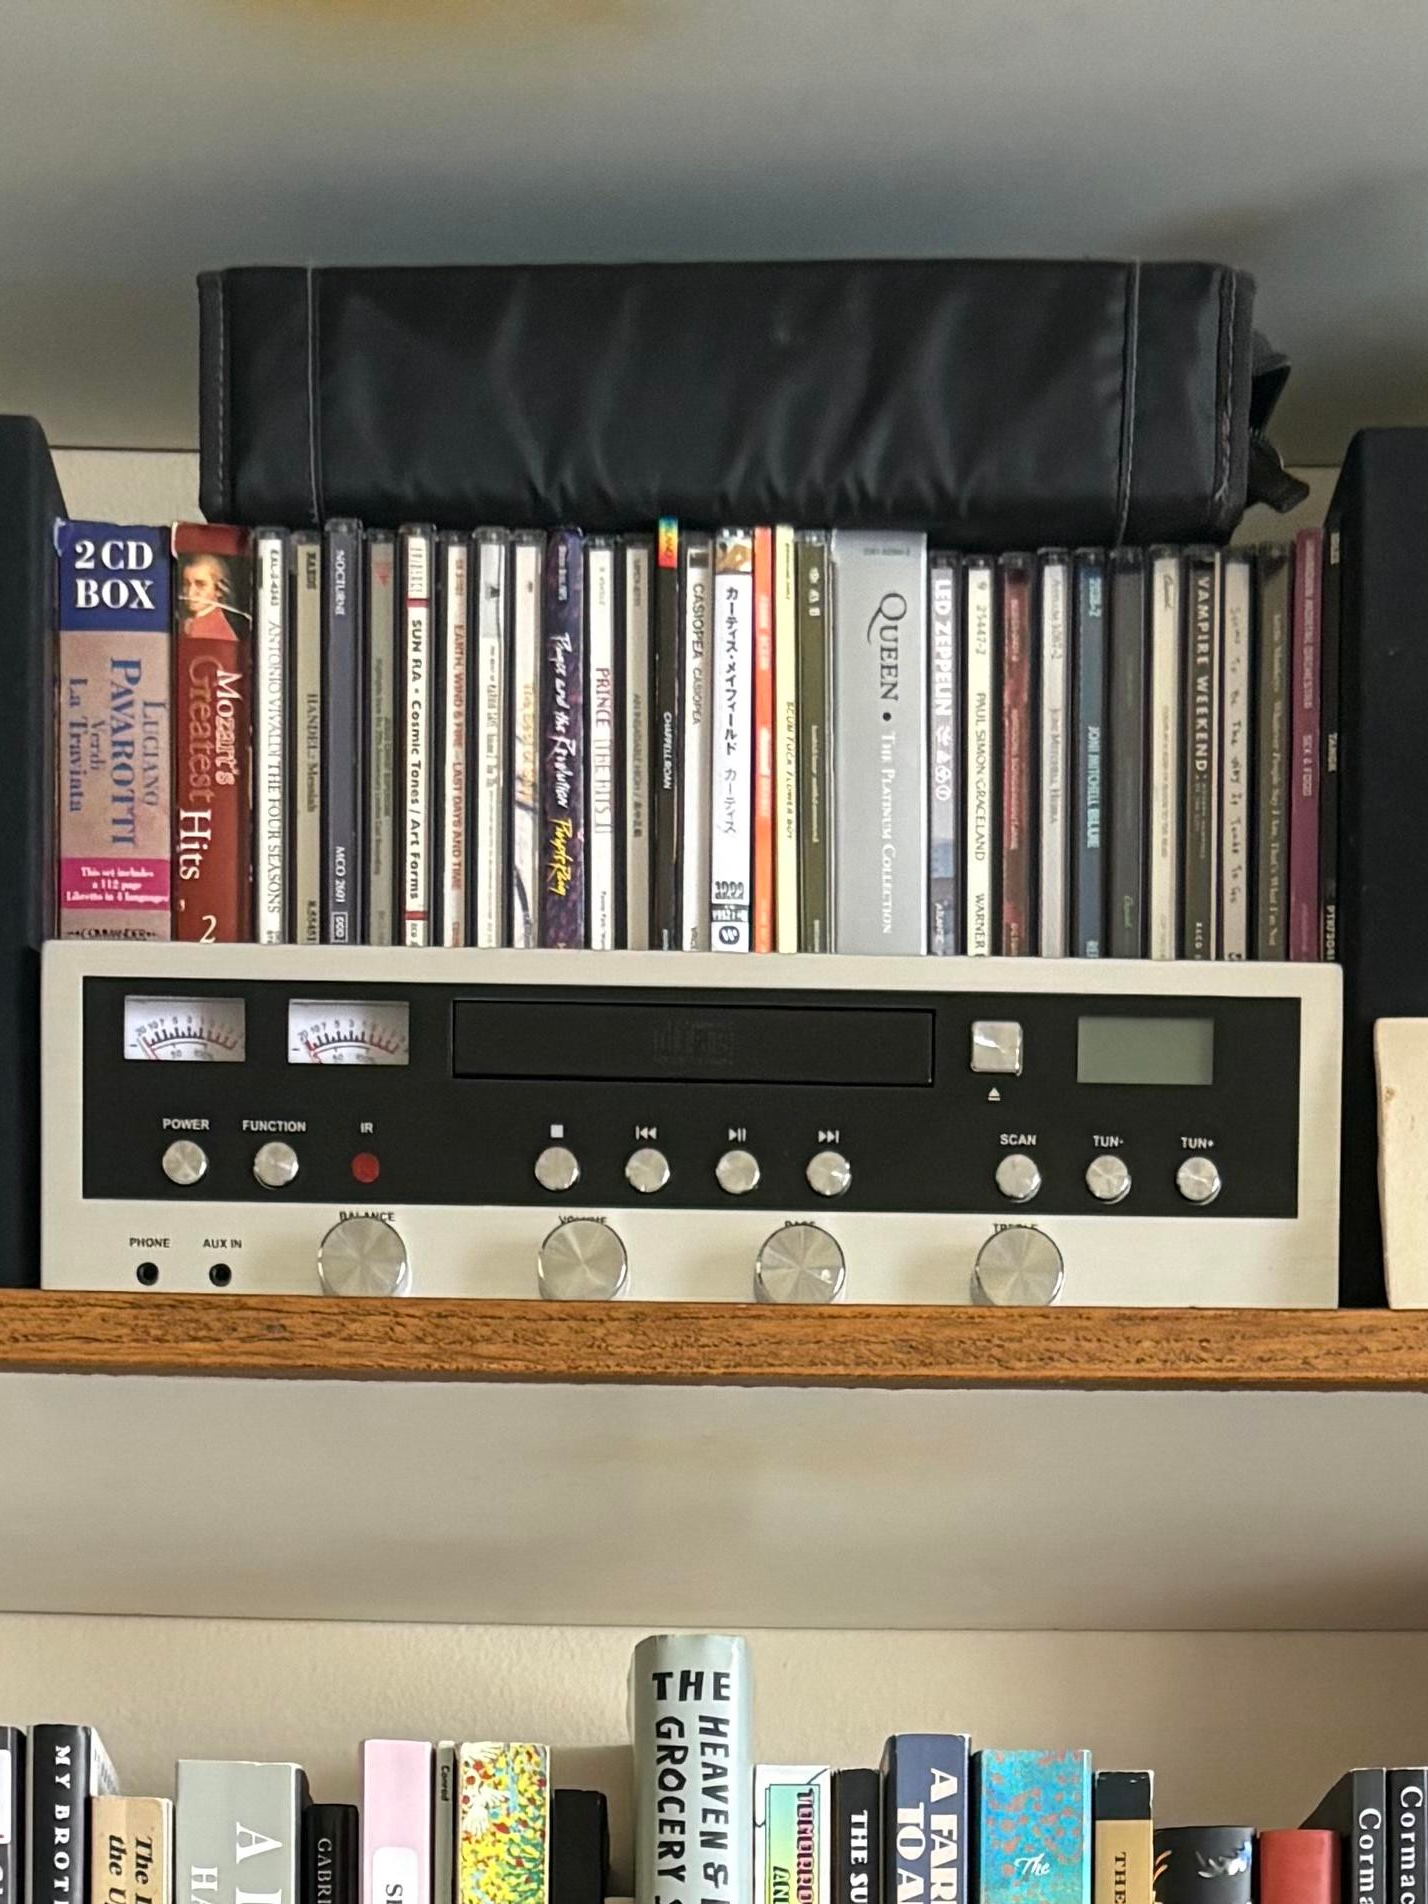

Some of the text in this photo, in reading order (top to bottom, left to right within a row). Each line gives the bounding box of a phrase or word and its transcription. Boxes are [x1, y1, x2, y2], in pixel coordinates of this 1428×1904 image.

[75, 540, 154, 571] 2 CD
[76, 579, 155, 610] BOX
[693, 583, 705, 663] CASIOPEA
[109, 657, 143, 846] PAVAROTTI
[408, 620, 422, 899] SUN RA Cosmic Tones Art Forms
[867, 592, 907, 934] QUEEN THE PLATINUM COLLECTION
[162, 1119, 373, 1134] POWER FUNCTION IR
[1000, 1134, 1037, 1146] SCAN
[1181, 1137, 1214, 1149] TUN+
[129, 1237, 243, 1249] PHONE AUX IN
[1014, 1854, 1051, 1878] The
